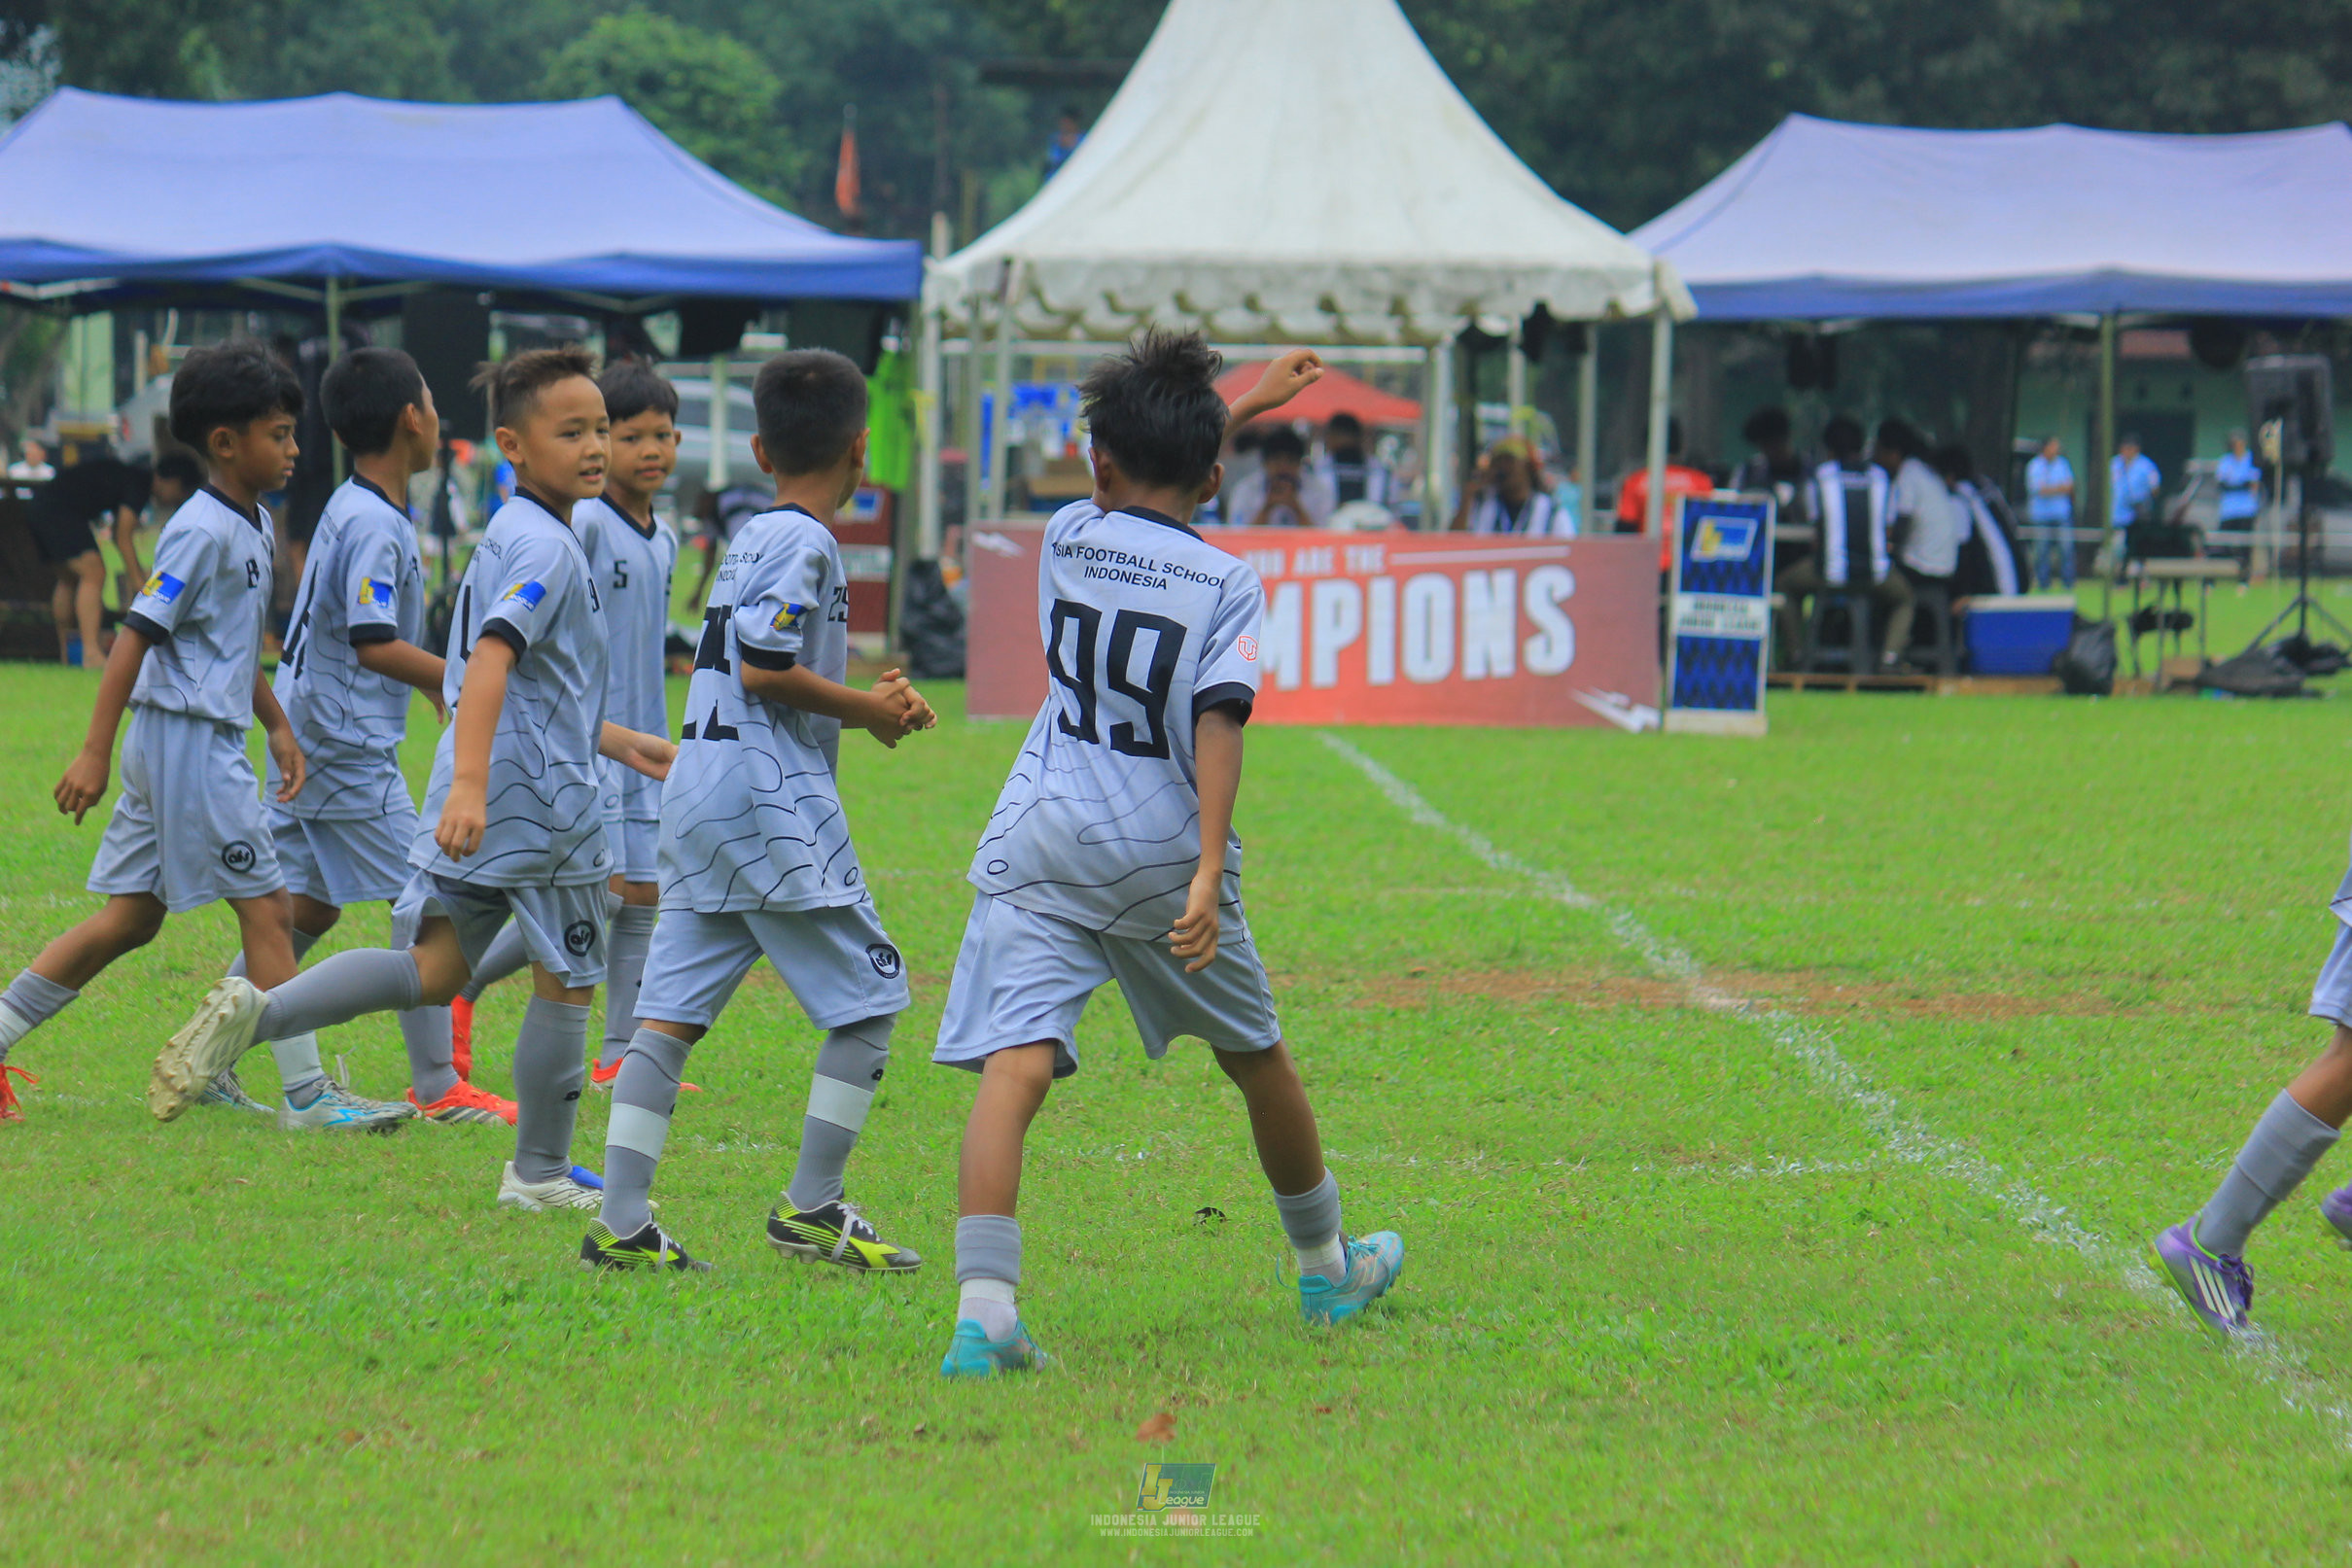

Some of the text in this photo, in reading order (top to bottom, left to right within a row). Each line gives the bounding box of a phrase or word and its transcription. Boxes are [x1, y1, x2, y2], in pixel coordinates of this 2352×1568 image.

[613, 559, 628, 589] 5
[1075, 545, 1159, 573] FOOTBALL
[1293, 545, 1336, 576] ARE
[1344, 542, 1387, 575] THE
[1083, 565, 1169, 591] INDONESIA
[1046, 598, 1188, 760] 99
